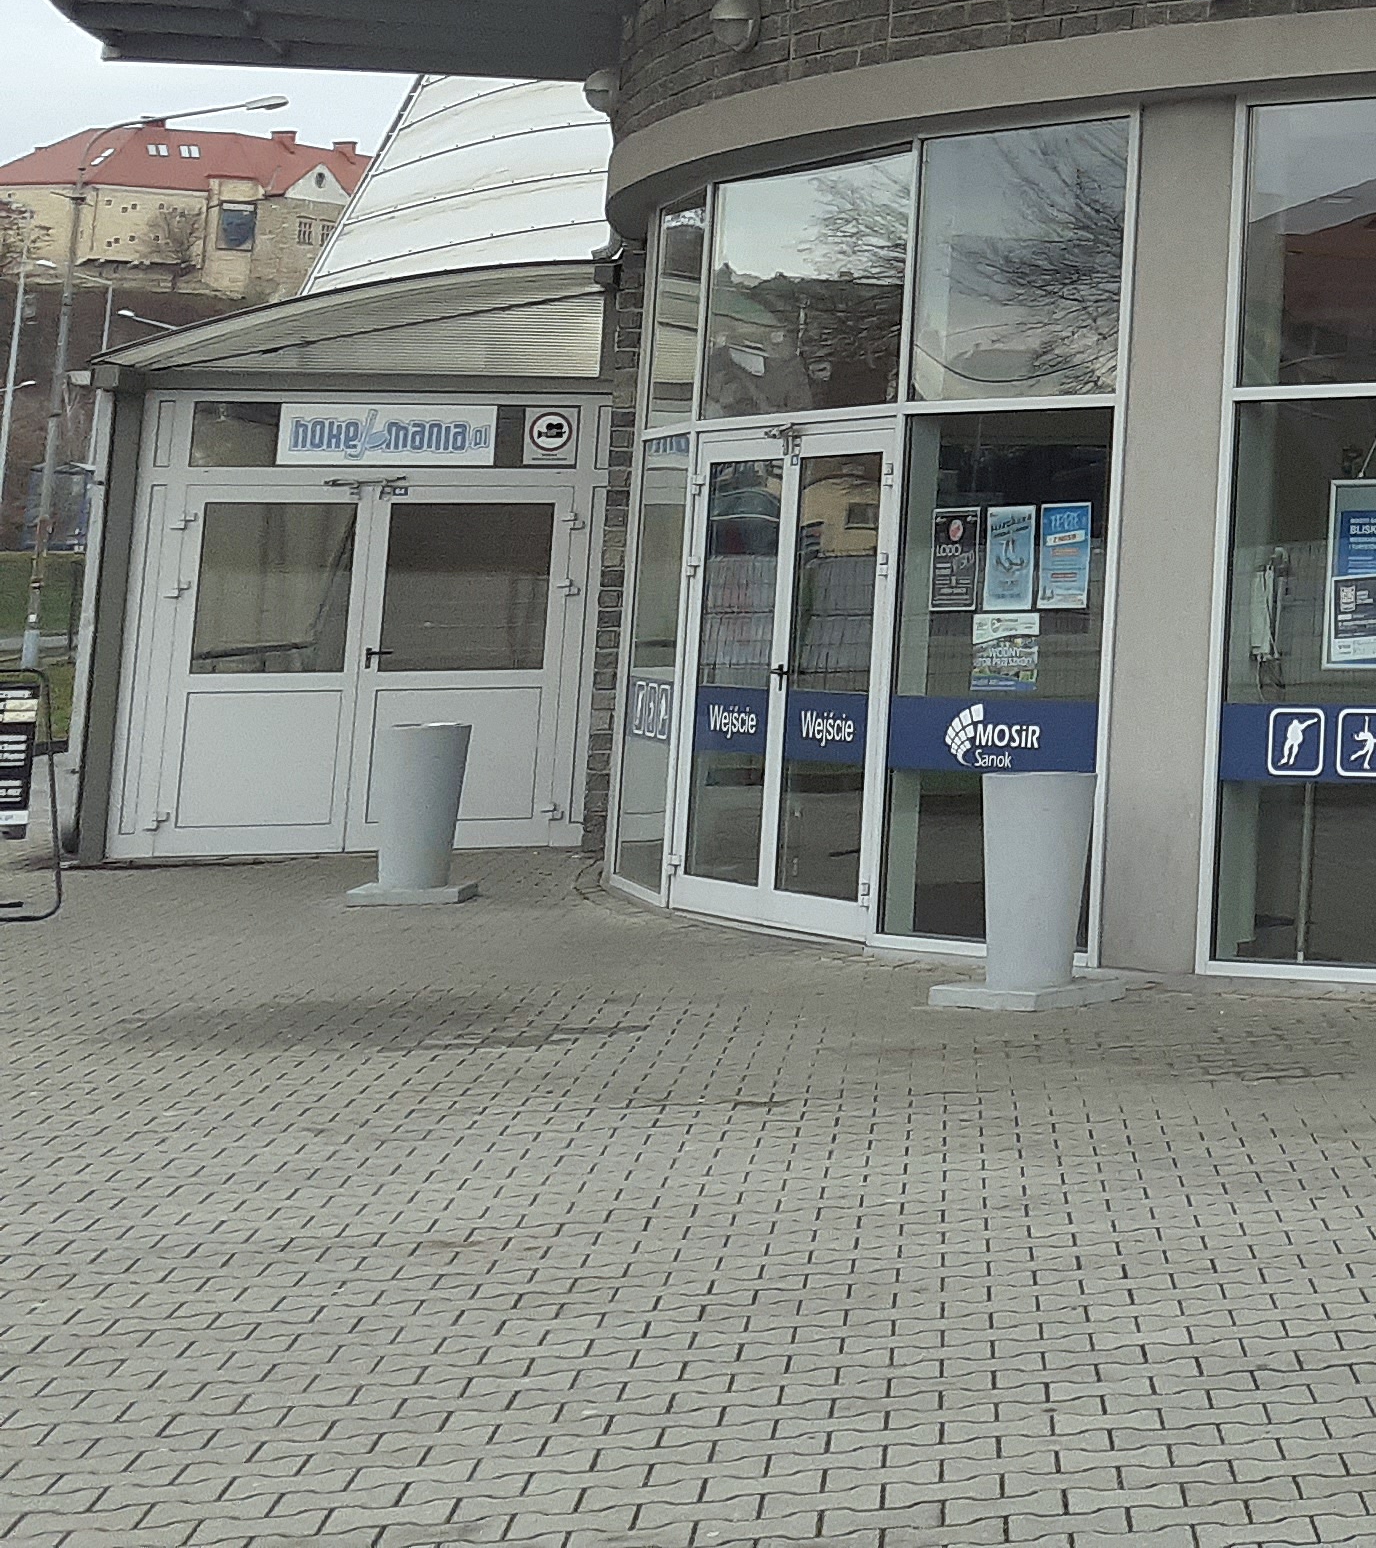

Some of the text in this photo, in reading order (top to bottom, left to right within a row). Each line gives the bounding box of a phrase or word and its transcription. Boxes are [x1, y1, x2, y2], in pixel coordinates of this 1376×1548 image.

[709, 704, 757, 739] Wejście
[801, 709, 854, 747] Wejście
[975, 723, 1041, 749] MOSiR
[974, 749, 1012, 769] Sanok
